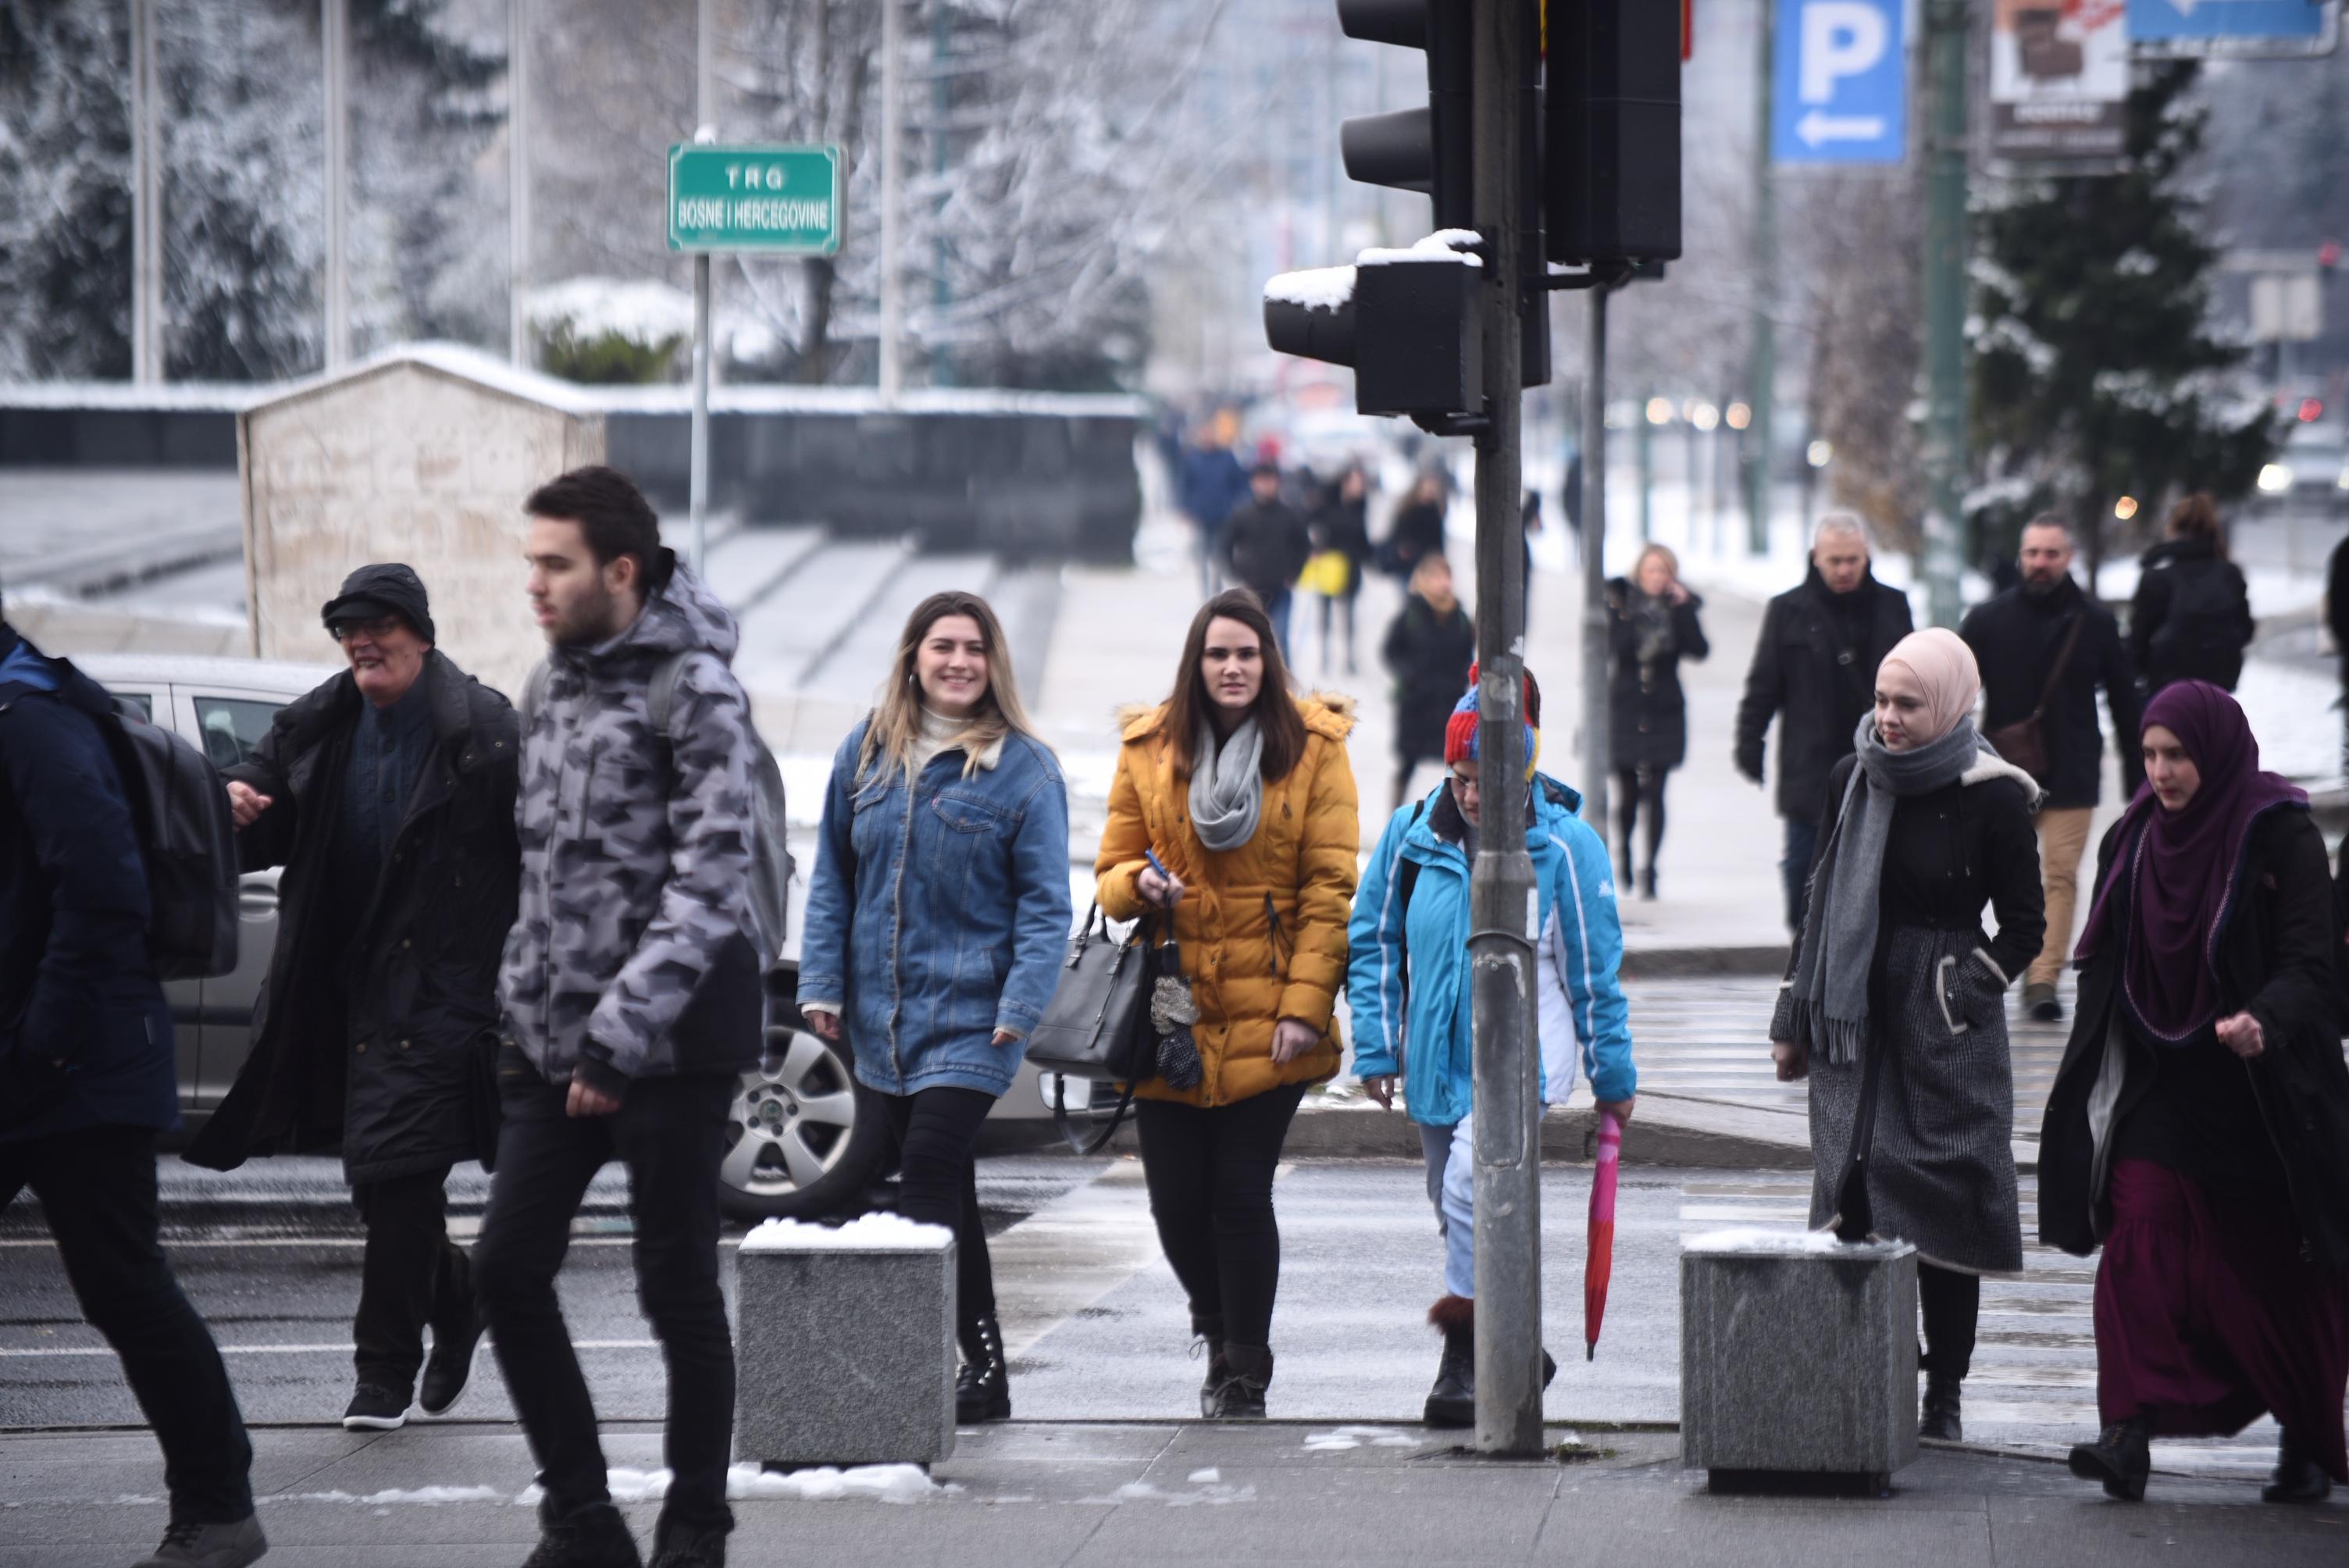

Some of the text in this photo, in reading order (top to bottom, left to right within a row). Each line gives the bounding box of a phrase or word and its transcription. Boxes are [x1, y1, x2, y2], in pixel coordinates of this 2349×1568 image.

[1799, 2, 1887, 103] P
[725, 165, 783, 190] TRG
[678, 199, 829, 230] BOSNE I HERCEGOVINE
